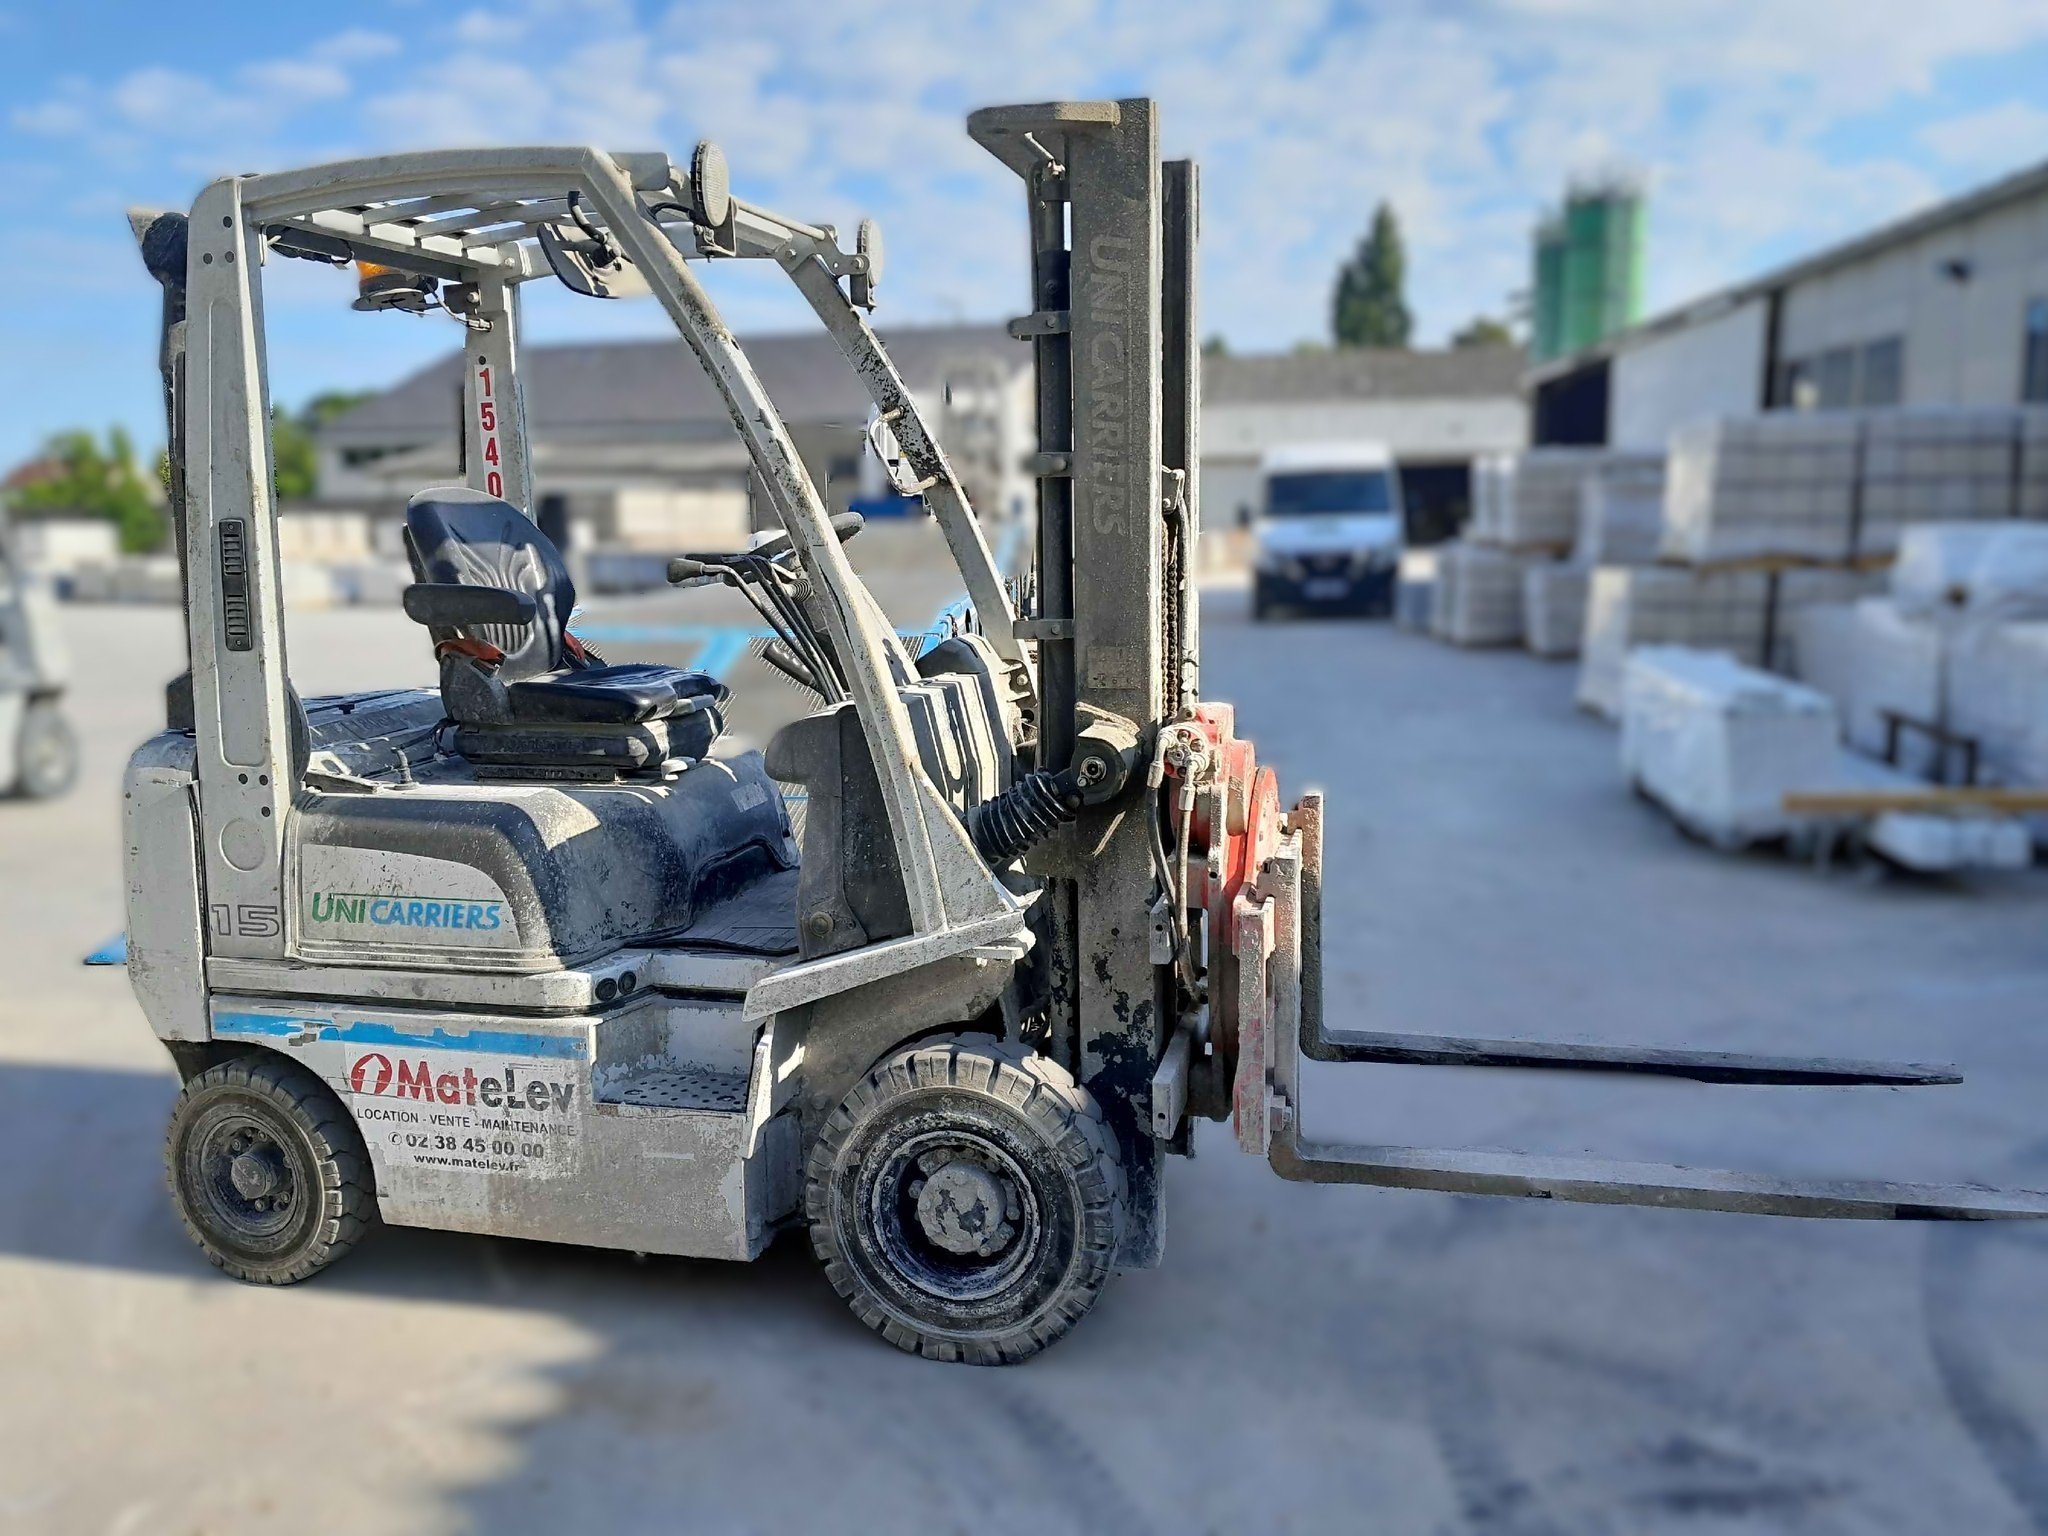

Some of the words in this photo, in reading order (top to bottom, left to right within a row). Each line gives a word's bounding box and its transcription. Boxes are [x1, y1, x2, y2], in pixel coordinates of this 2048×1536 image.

[1089, 234, 1131, 538] UNICARRIERS
[479, 367, 503, 499] 1540
[211, 904, 280, 937] 15
[397, 1059, 575, 1113] MateLev
[357, 1108, 418, 1123] LOCATION
[429, 1113, 471, 1128] VENTE
[405, 1133, 428, 1148] 02
[434, 1135, 457, 1150] 38
[462, 1138, 486, 1153] 45
[492, 1140, 515, 1156] 00
[521, 1143, 544, 1159] 00
[413, 1154, 520, 1172] www.matelev.fr
